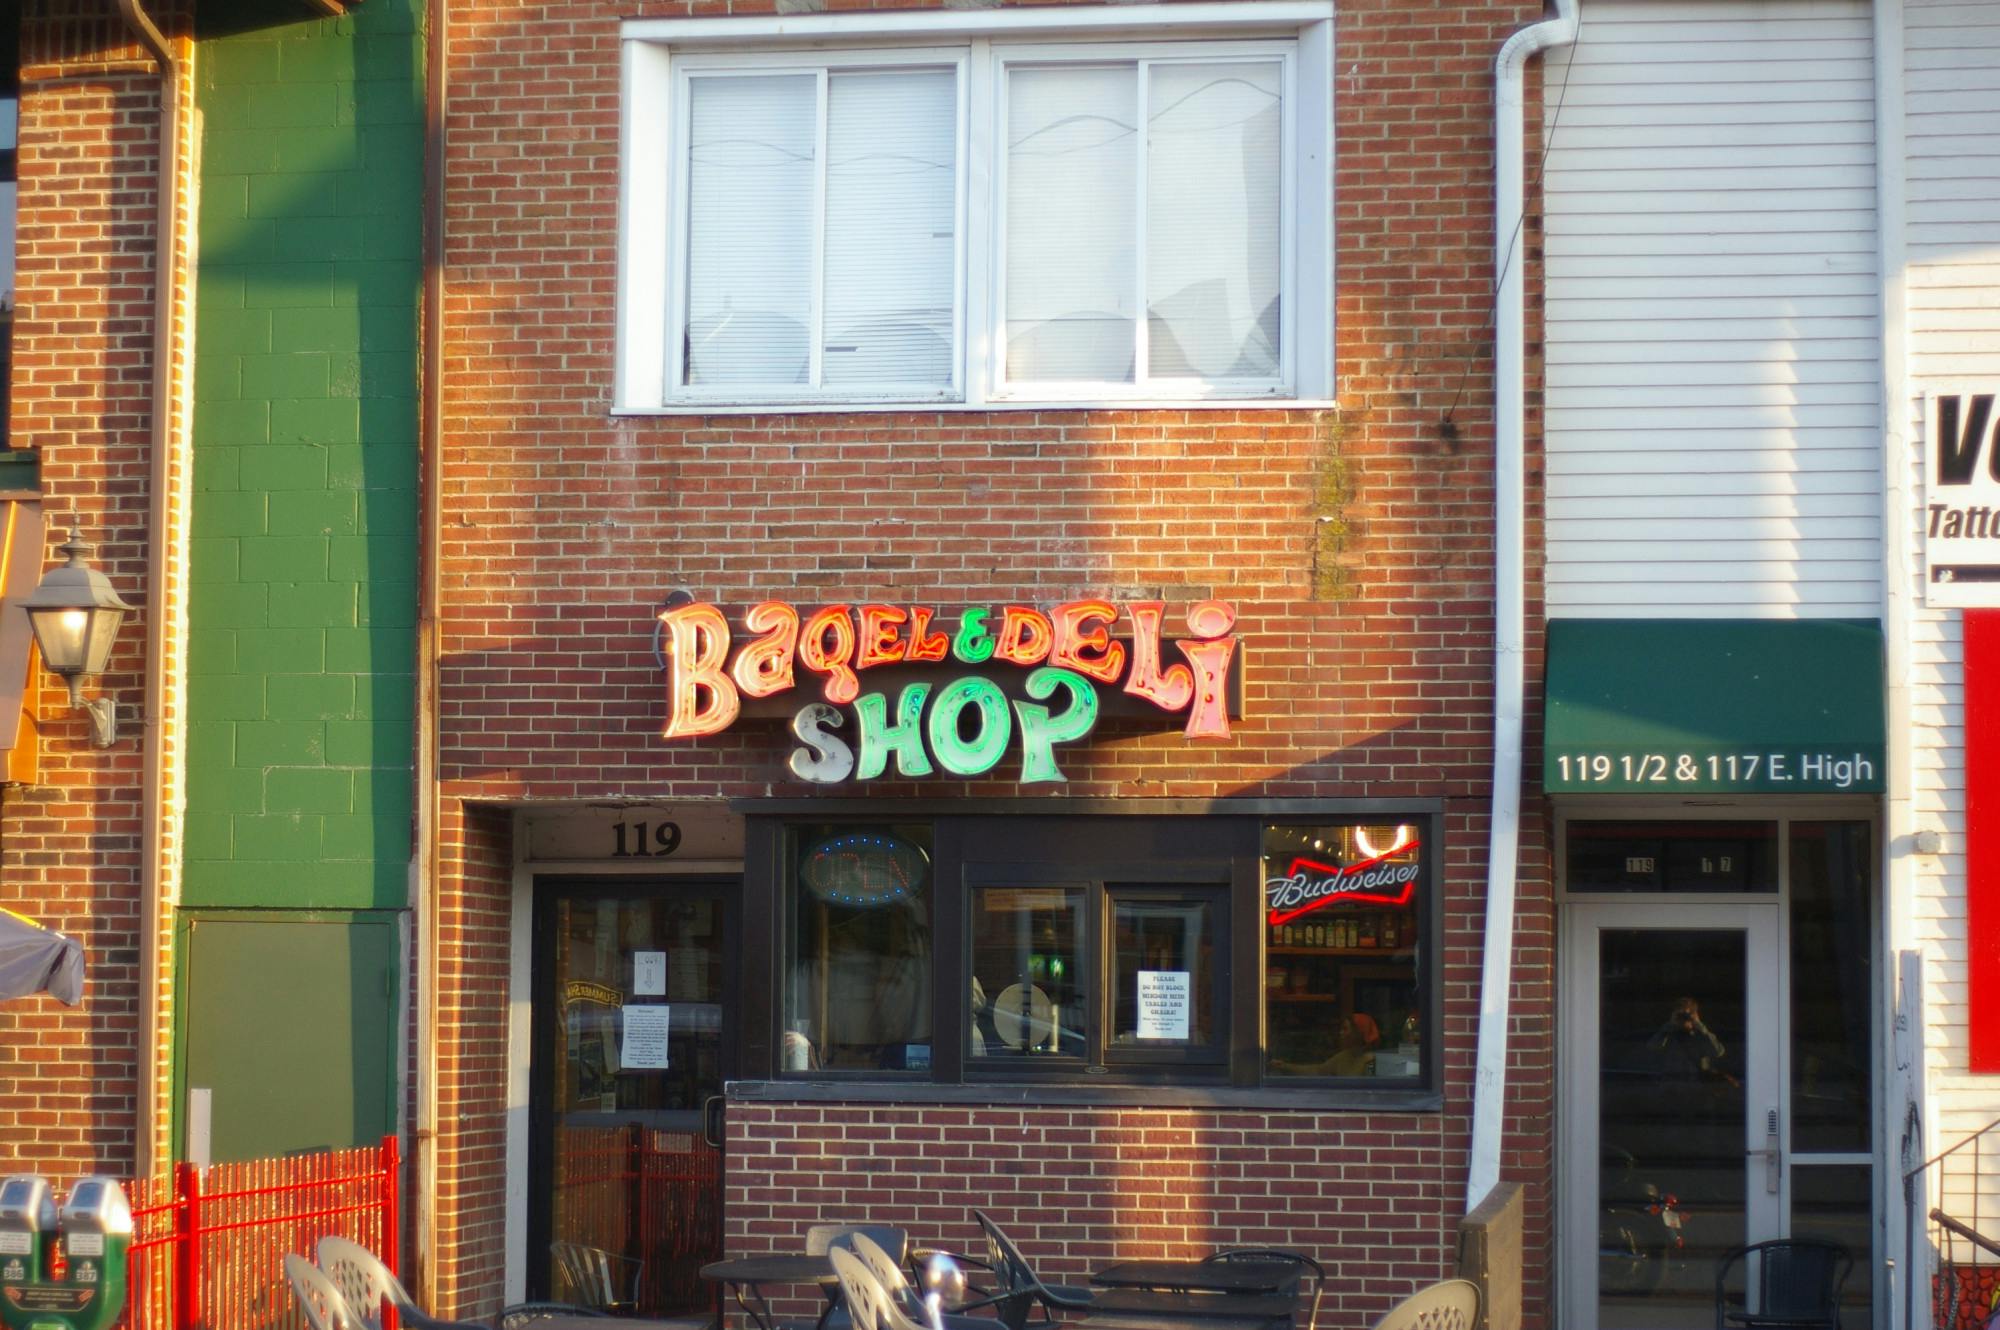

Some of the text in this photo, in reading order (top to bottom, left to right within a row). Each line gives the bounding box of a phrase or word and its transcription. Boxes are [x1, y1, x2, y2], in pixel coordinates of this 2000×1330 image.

[1937, 394, 2000, 486] V
[953, 607, 995, 664] &
[1557, 752, 1873, 788] 119 1/2 & 117 E. High
[611, 821, 682, 857] 119
[1265, 863, 1420, 908] Budweiser
